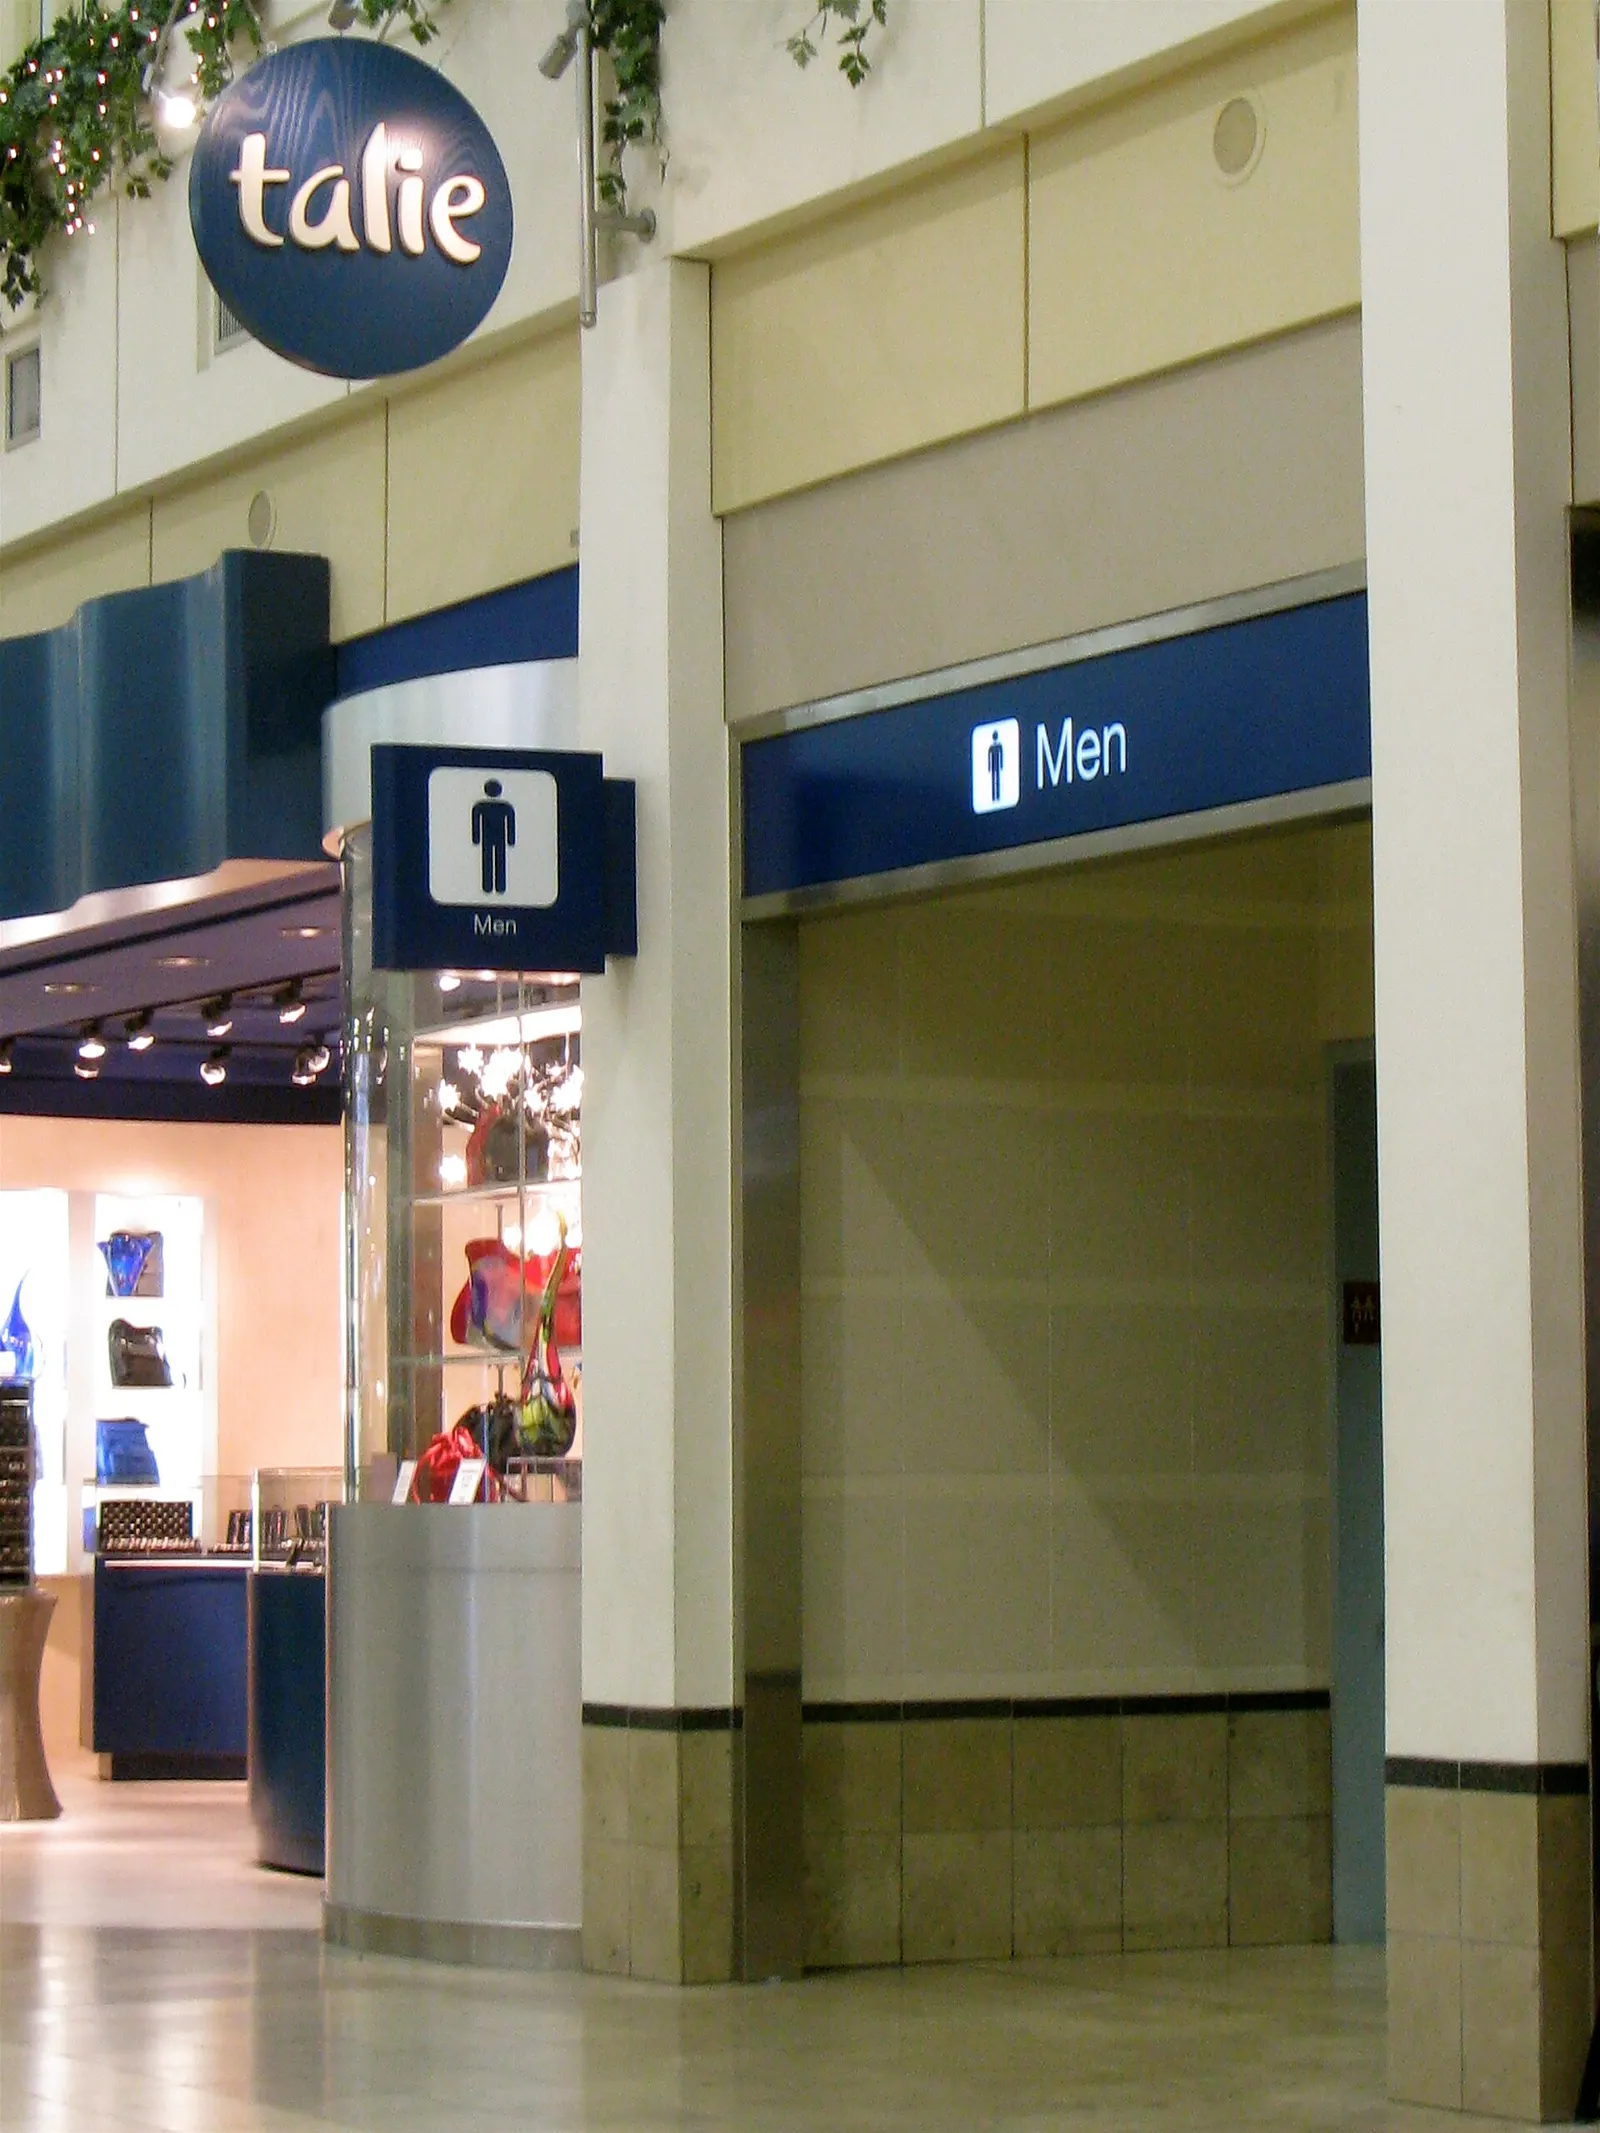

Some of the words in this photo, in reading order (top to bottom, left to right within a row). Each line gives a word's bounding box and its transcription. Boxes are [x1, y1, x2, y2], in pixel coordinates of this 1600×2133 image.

[230, 122, 486, 264] talie
[1036, 716, 1127, 790] Men
[474, 913, 518, 936] Men
